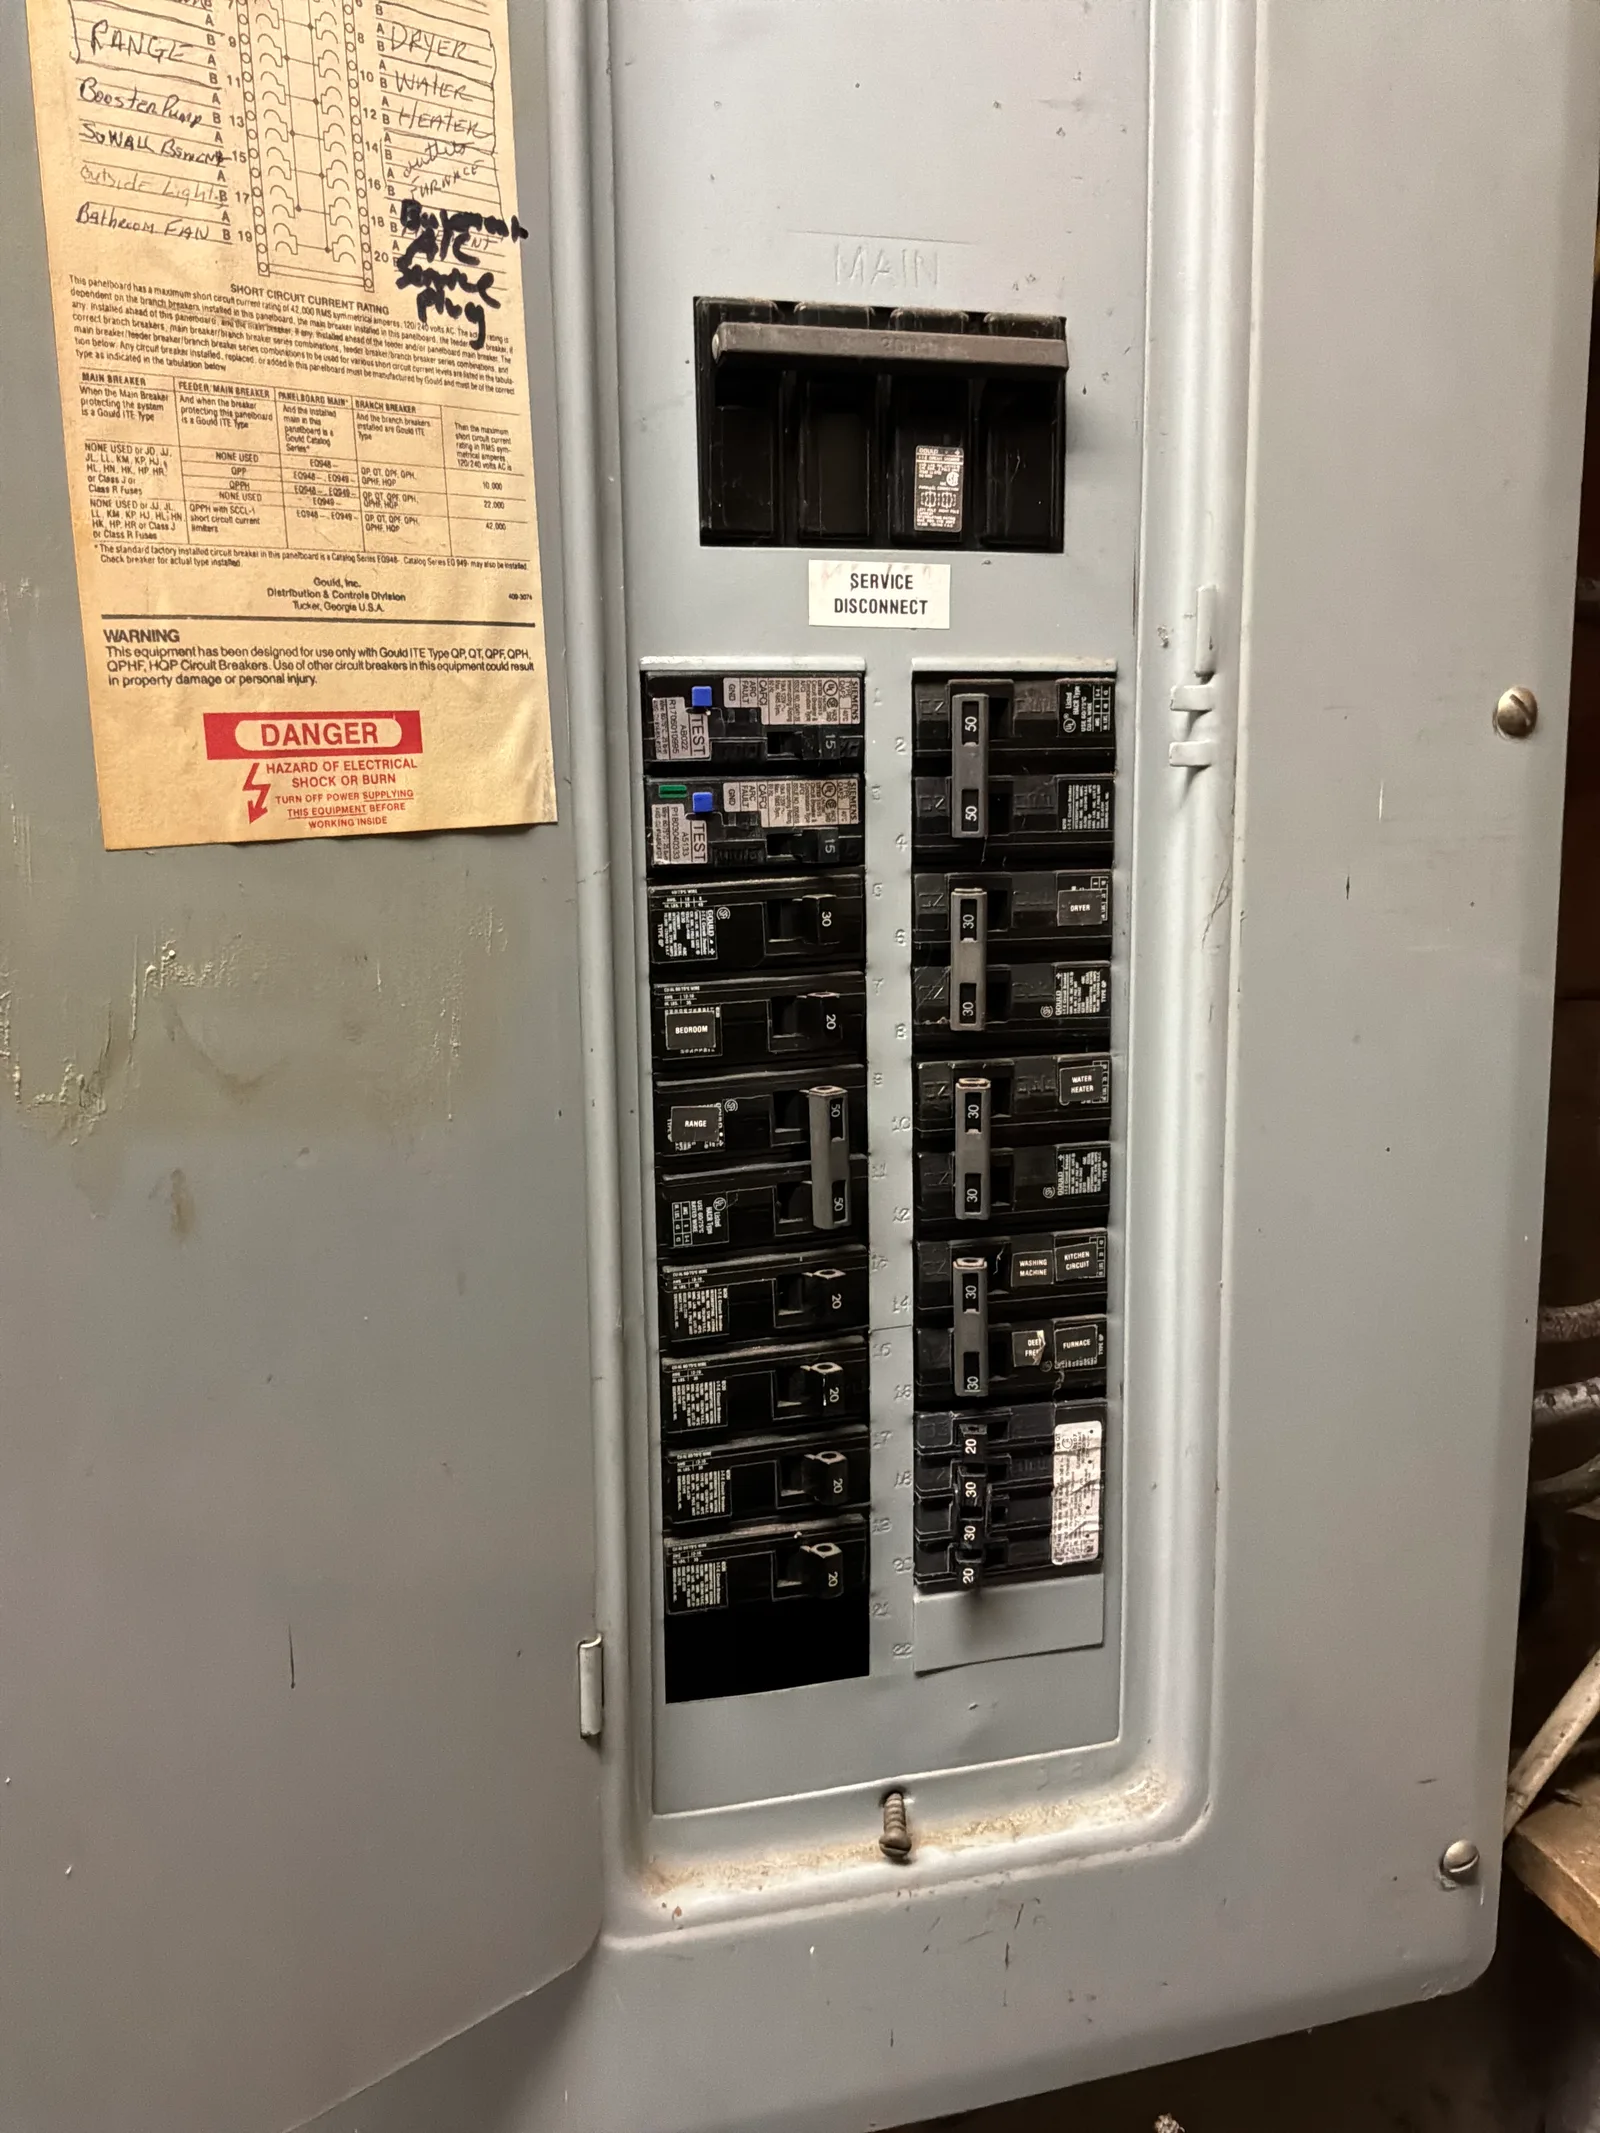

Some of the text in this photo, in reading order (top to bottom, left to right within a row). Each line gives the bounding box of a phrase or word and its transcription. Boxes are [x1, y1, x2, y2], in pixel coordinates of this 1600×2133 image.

[91, 20, 193, 63] RANGE
[357, 34, 364, 43] 8
[391, 22, 479, 63] DRYER
[227, 75, 241, 87] 11
[360, 71, 373, 82] 10
[230, 116, 244, 127] 13
[363, 109, 377, 120] 12
[366, 142, 378, 152] 14
[232, 151, 246, 163] 15
[368, 179, 381, 189] 16
[236, 191, 249, 202] 17
[371, 216, 384, 227] 18
[239, 231, 252, 241] 19
[374, 251, 388, 262] 20
[834, 244, 940, 289] MAIN
[230, 284, 389, 315] SHORT CIRCUIT CURRENT RATING
[82, 372, 146, 386] MAIN BREAKER
[313, 577, 361, 589] Gould, Inc.
[850, 572, 914, 591] SERVICE
[266, 588, 320, 598] Distribution
[332, 590, 369, 600] Controls
[372, 592, 406, 601] Division
[292, 600, 323, 612] Tucker,
[324, 601, 357, 613] Georgia
[833, 597, 928, 616] DISCONNECT
[103, 629, 180, 643] WARNING
[106, 646, 132, 657] This
[134, 647, 196, 660] equipment
[198, 647, 219, 657] has
[221, 647, 249, 657] been
[250, 647, 299, 660] designed
[300, 647, 314, 658] for
[316, 649, 334, 658] use
[336, 648, 356, 660] only
[357, 648, 378, 658] with
[379, 648, 408, 658] Gould
[410, 648, 426, 658] ITE
[430, 649, 450, 660] Type
[107, 660, 147, 672] QPHF,
[149, 660, 179, 672] HQP
[180, 660, 217, 671] Circuit
[218, 660, 272, 671] Breakers.
[273, 661, 294, 671] Use
[308, 661, 333, 671] other
[335, 661, 364, 671] circuit
[365, 661, 407, 672] breakers
[409, 662, 418, 671] in
[419, 661, 435, 672] this
[437, 662, 485, 673] equipment
[486, 662, 509, 672] could
[511, 663, 534, 672] result
[109, 673, 317, 687] in property damage or personal injury.
[728, 683, 736, 702] GND
[850, 680, 858, 720] SIEMENS
[965, 716, 977, 732] 50
[260, 722, 378, 747] DANGER
[692, 716, 706, 756] TEST
[825, 734, 836, 749] 15
[266, 759, 417, 774] HAZARD OF ELECTRICAL
[292, 774, 396, 788] SHOCK OR BURN
[275, 789, 414, 804] TURN OFF POWER SUPPLYING
[728, 788, 736, 806] GND
[288, 803, 406, 817] THIS EQUIPMENT BEFORE
[965, 806, 977, 822] 50
[308, 816, 388, 829] WORKING INSIDE
[693, 824, 706, 861] TEST
[825, 838, 836, 853] 15
[1070, 904, 1090, 912] DRYER
[822, 911, 832, 927] 30
[963, 914, 974, 929] 30
[962, 1002, 974, 1016] 30
[826, 1014, 836, 1030] 20
[675, 1025, 708, 1034] BEDROOM
[1072, 1075, 1092, 1083] WATER
[1070, 1085, 1094, 1093] HEATER
[831, 1103, 840, 1117] 50
[967, 1104, 979, 1119] 30
[684, 1120, 707, 1128] RANGE
[966, 1188, 978, 1203] 30
[834, 1197, 843, 1212] 50
[1064, 1251, 1090, 1260] KITCHEN
[1019, 1259, 1048, 1267] WASHING
[1066, 1260, 1090, 1270] CIRCUIT
[966, 1285, 977, 1300] 30
[831, 1294, 842, 1309] 20
[1063, 1339, 1091, 1349] FURNACE
[967, 1376, 978, 1390] 30
[829, 1387, 839, 1403] 20
[965, 1438, 977, 1455] 20
[832, 1477, 843, 1494] 20
[966, 1481, 977, 1498] 30
[964, 1525, 976, 1541] 30
[828, 1571, 838, 1587] 20
[963, 1567, 974, 1584] 20
